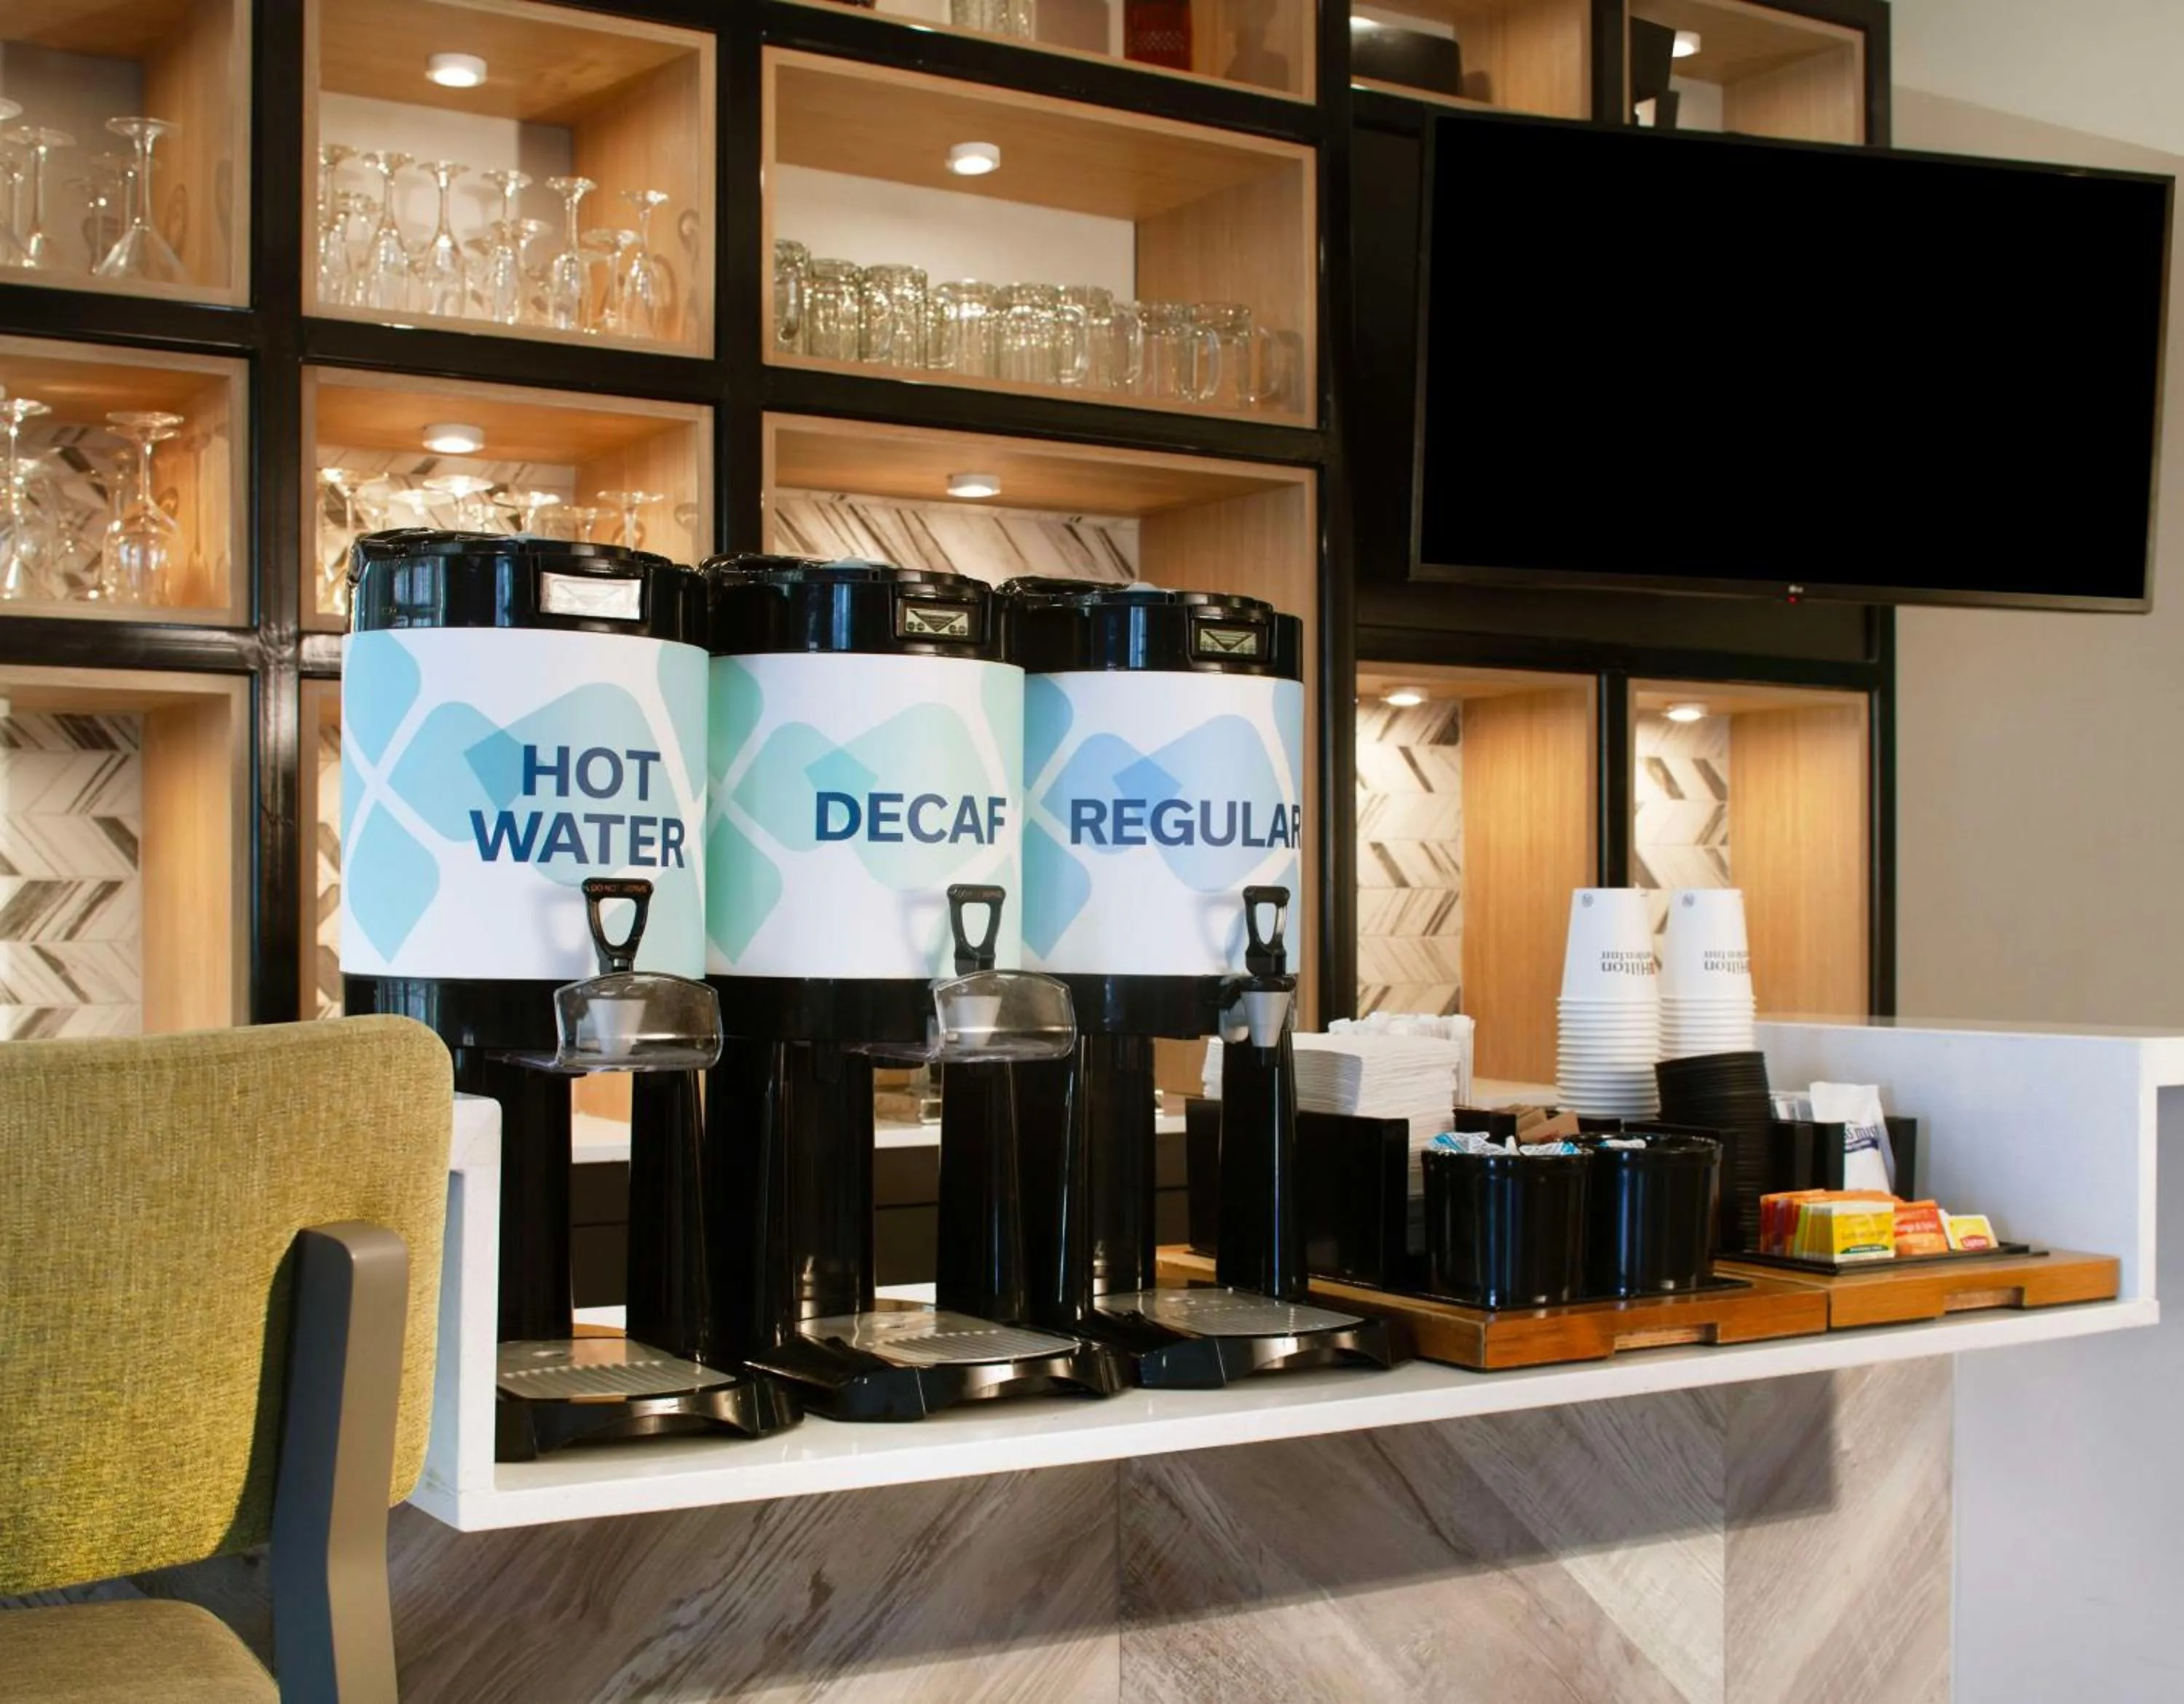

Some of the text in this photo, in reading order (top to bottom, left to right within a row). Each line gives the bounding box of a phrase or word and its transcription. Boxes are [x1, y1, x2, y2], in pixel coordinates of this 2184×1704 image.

[523, 743, 660, 802] HOT
[469, 809, 685, 869] WATER
[815, 791, 1007, 845] DECAF
[1071, 798, 1301, 850] REGULAR
[1602, 961, 1650, 976] Hilton
